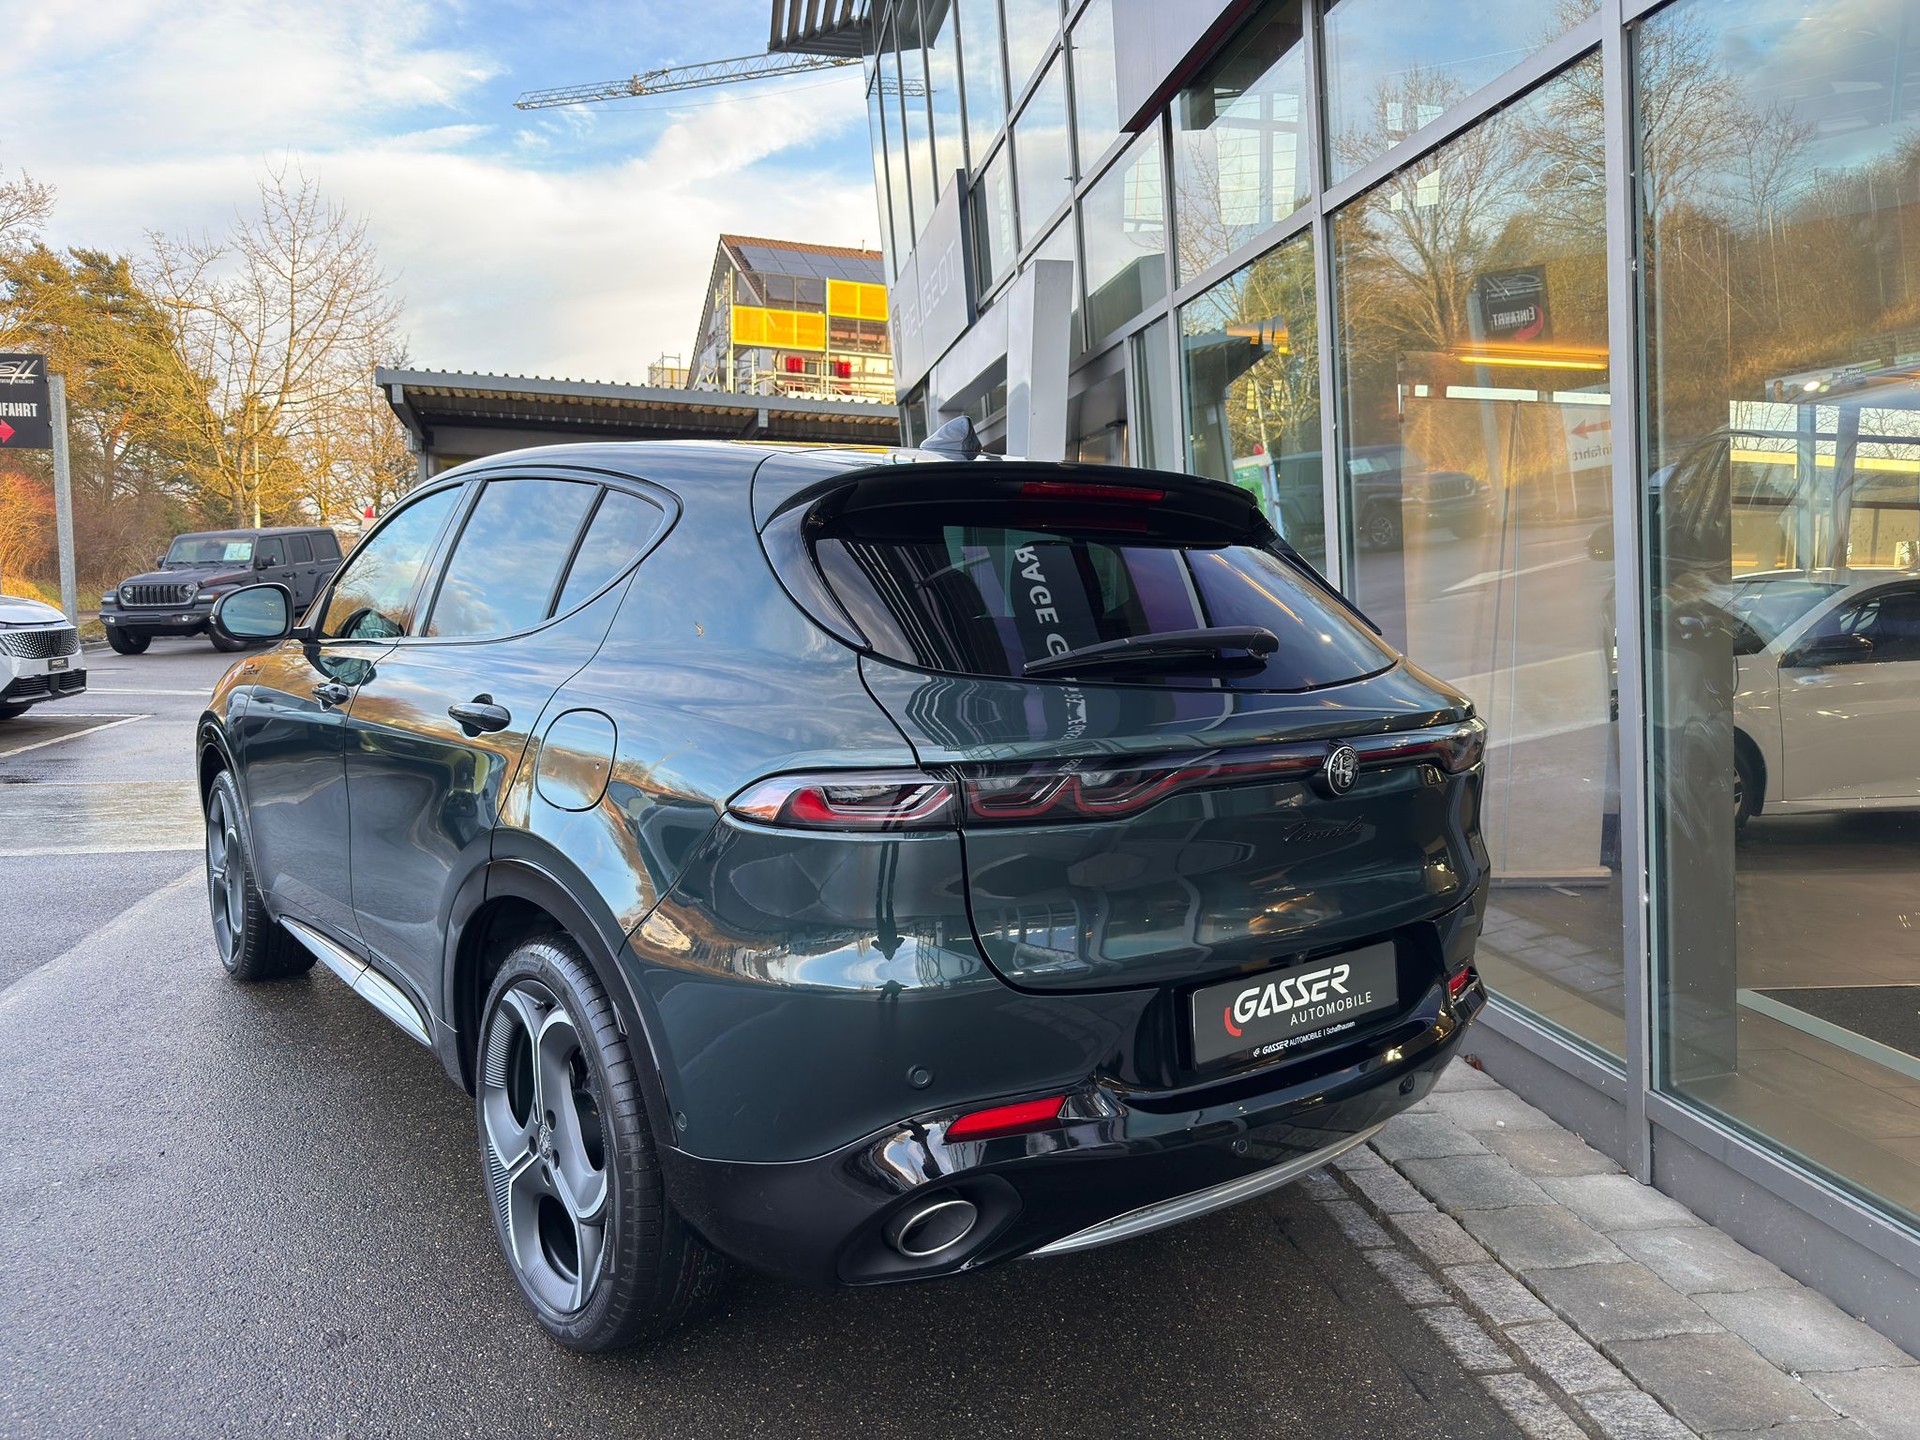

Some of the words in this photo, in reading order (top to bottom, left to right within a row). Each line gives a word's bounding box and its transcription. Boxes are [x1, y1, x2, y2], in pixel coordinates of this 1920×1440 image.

[903, 240, 955, 338] PEUGEOT
[0, 403, 38, 417] FAHRT
[1233, 963, 1350, 1024] GASSER
[1290, 991, 1372, 1027] AUTOMOBILE
[1262, 1039, 1289, 1055] GASSER
[1289, 1030, 1322, 1046] AUTOMOBILE
[1326, 1021, 1356, 1035] Schaffhausen
